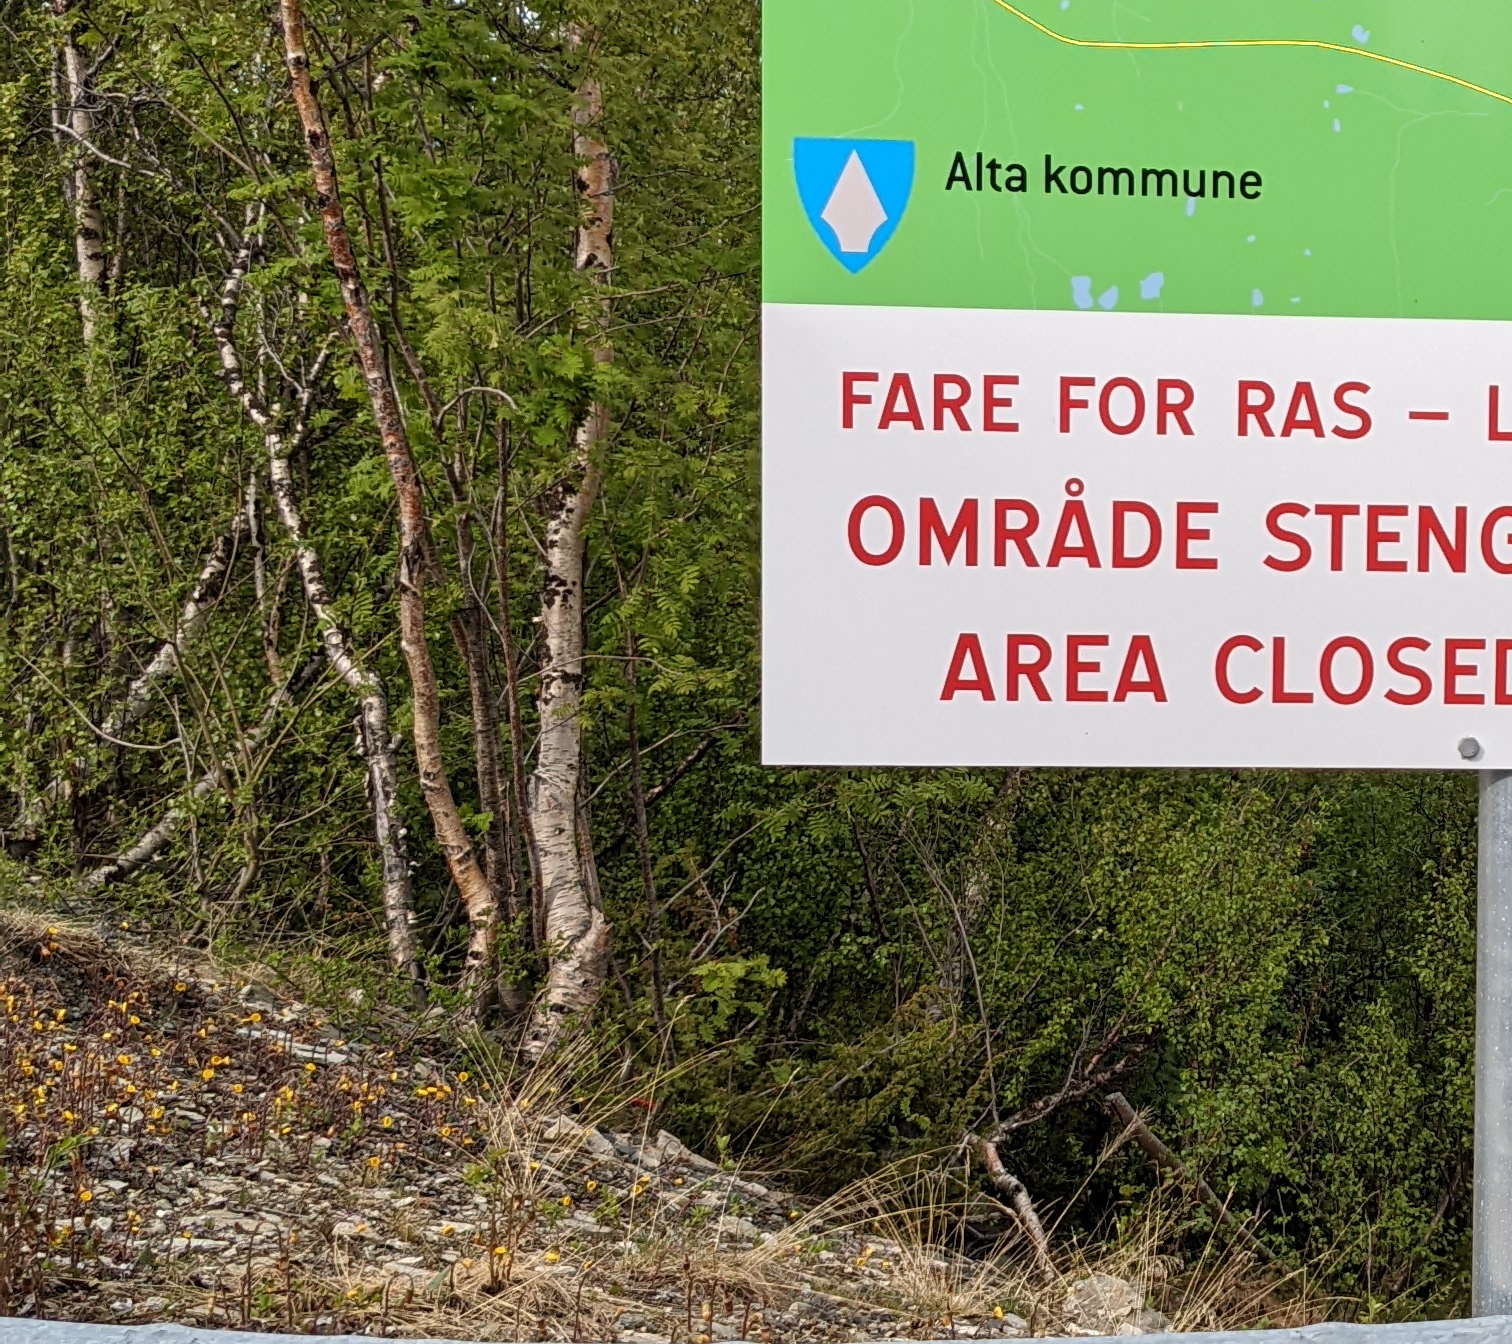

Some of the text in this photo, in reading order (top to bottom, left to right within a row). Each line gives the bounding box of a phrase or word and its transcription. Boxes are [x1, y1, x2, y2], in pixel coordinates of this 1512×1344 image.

[944, 151, 1263, 200] Alta kommune
[841, 371, 1019, 433] FARE
[1058, 376, 1194, 437] FOR
[1237, 379, 1372, 440] RAS
[846, 478, 1219, 571] OMRÅDE
[939, 633, 1167, 703] AREA
